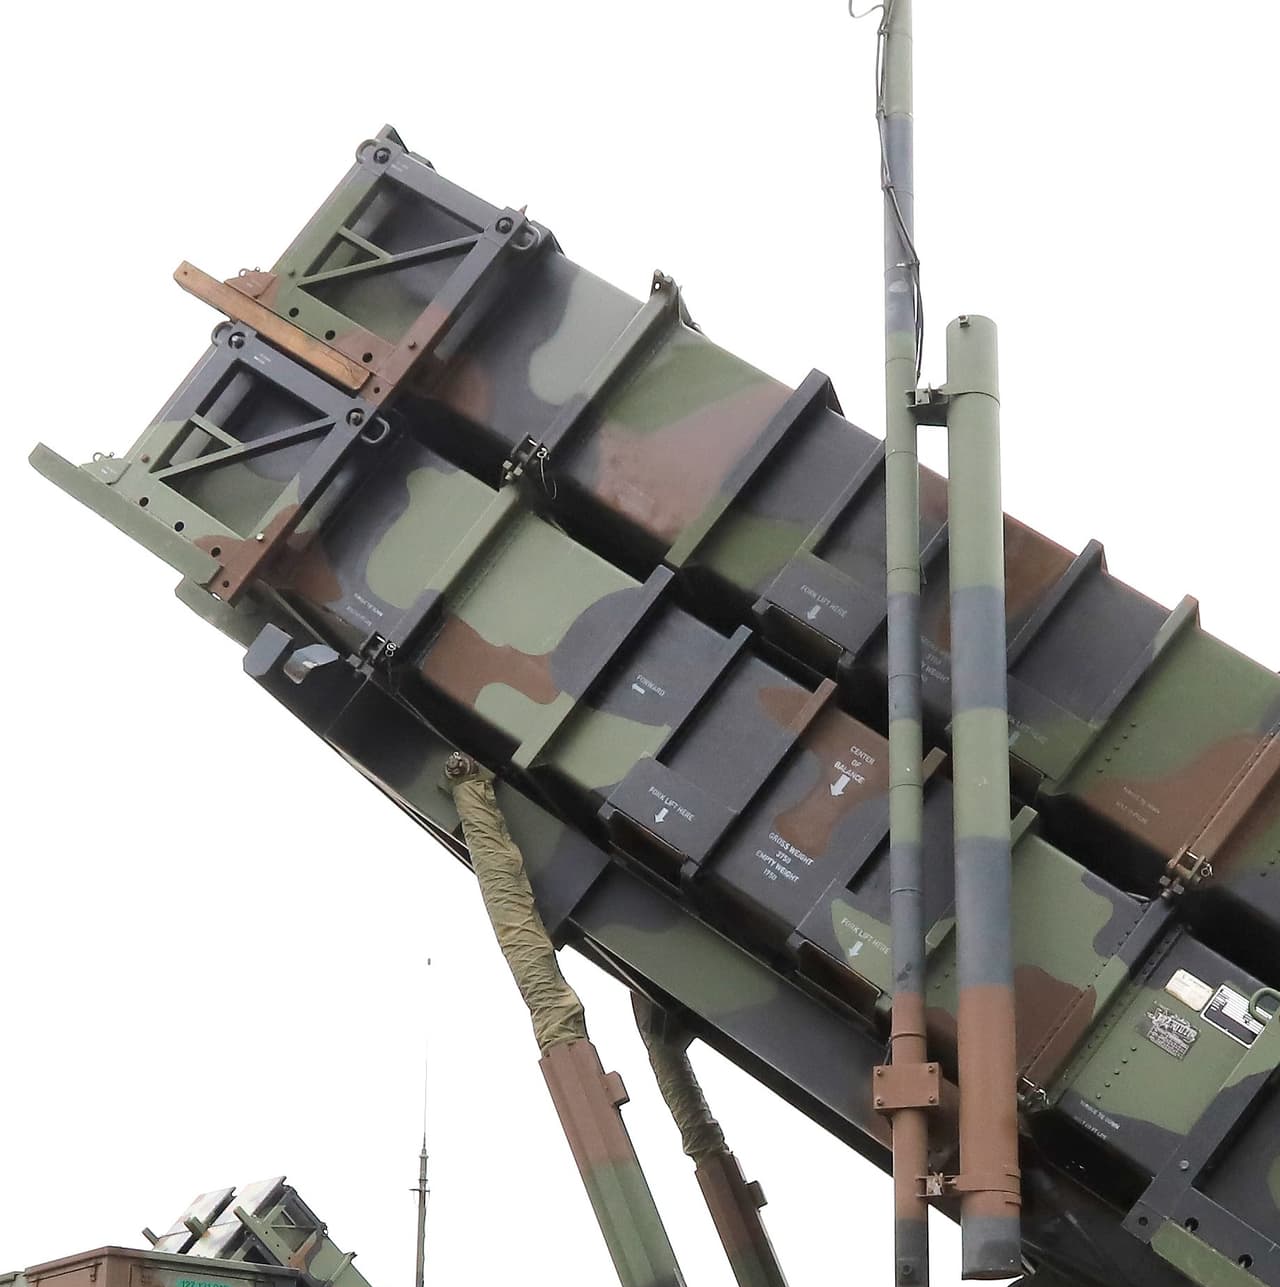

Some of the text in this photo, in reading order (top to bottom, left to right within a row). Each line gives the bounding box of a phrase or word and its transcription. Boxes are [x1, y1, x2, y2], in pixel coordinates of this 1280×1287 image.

[636, 674, 665, 697] FORWARD
[850, 745, 876, 765] CENTER
[851, 759, 862, 767] OF
[834, 761, 865, 784] BALANCE
[648, 786, 695, 822] FORK LIFT HERE
[768, 832, 814, 866] GROSS WEIGHT
[775, 850, 792, 865] 3750
[755, 849, 800, 883] EMPTY WEIGHT
[841, 917, 891, 955] FORK LIFT HERE
